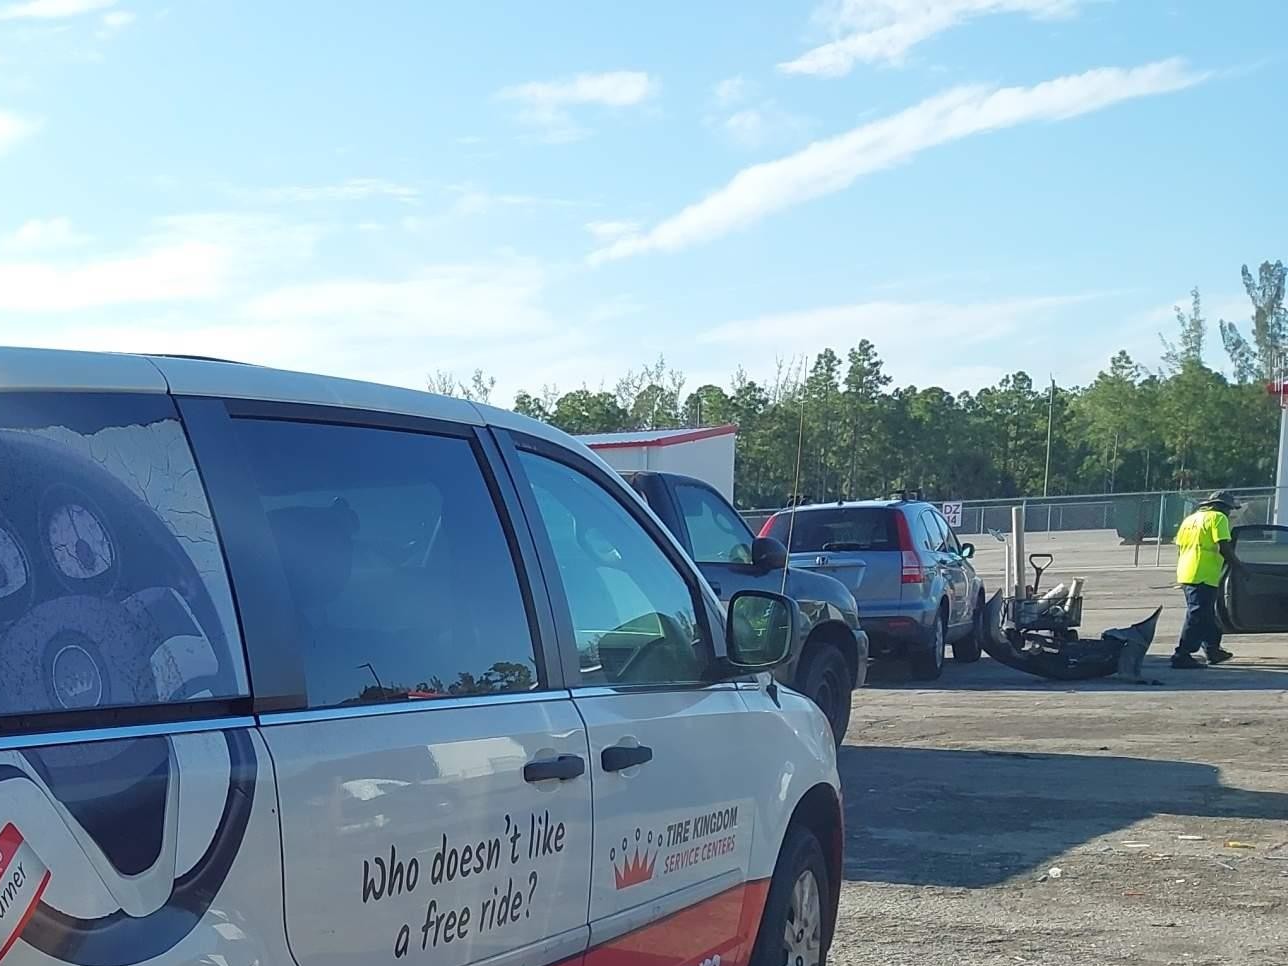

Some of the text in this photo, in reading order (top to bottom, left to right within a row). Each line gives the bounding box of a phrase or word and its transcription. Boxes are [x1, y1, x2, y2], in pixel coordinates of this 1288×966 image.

[944, 504, 960, 514] DZ
[666, 806, 738, 847] TIRE KINGDOM
[362, 810, 565, 903] Who doesn't like
[664, 834, 736, 874] SERVICE CENTERS
[394, 871, 538, 958] a free ride?
